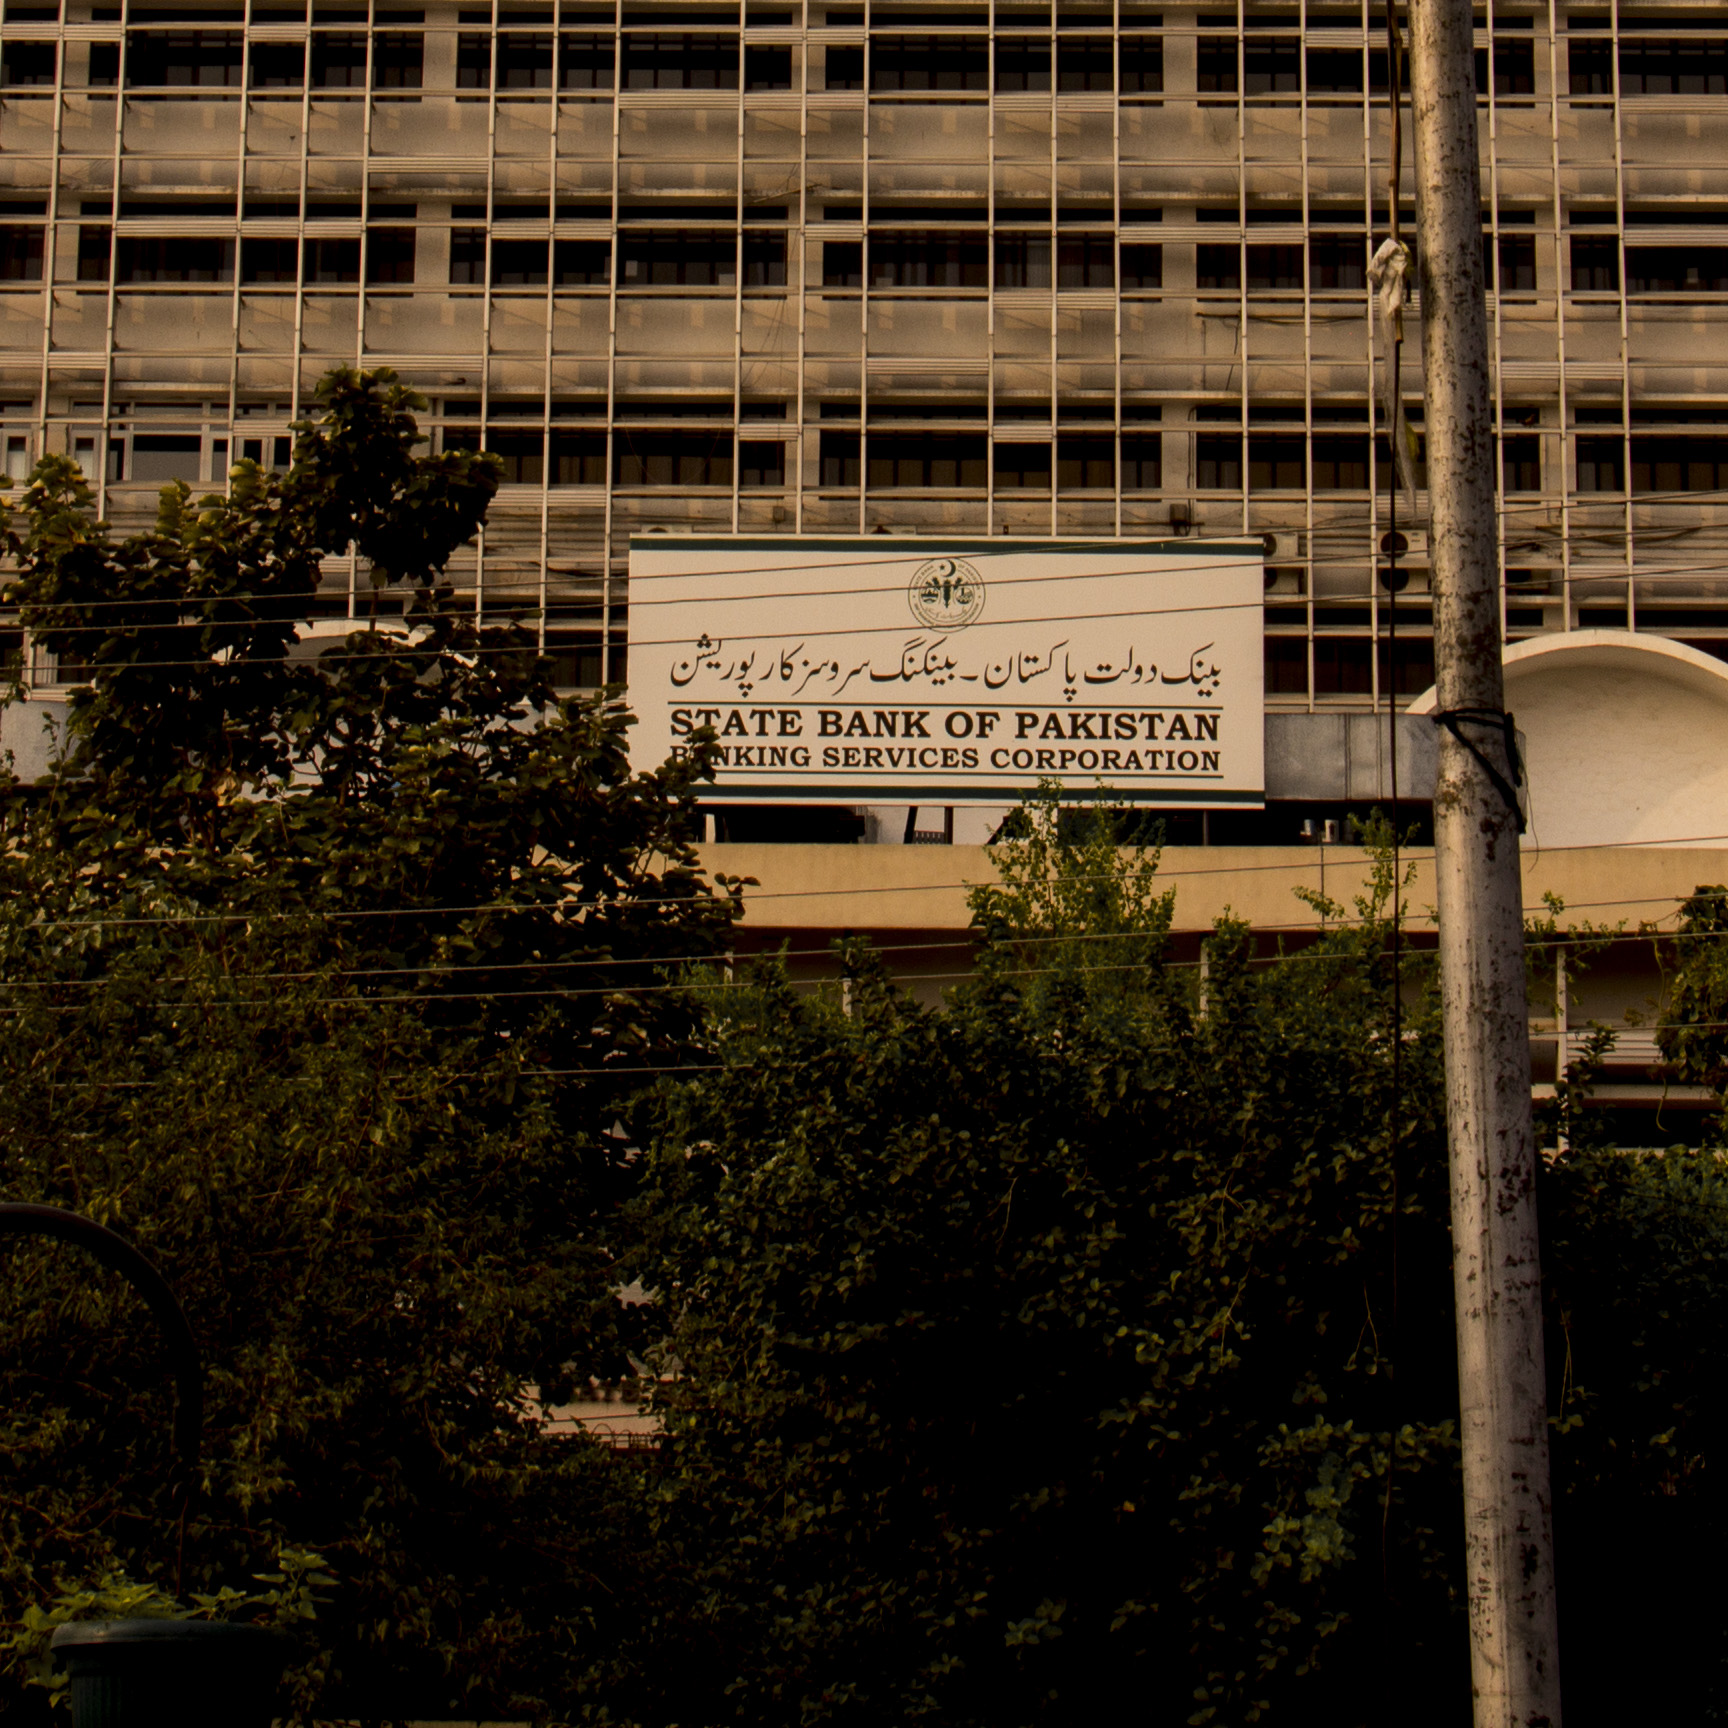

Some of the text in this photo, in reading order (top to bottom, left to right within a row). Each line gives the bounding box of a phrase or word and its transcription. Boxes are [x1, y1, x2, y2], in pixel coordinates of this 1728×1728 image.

[790, 658, 872, 697] سروسز
[868, 638, 956, 685] بینکنگ
[985, 642, 1076, 702] پاکستان
[1084, 648, 1157, 684] دولت
[1160, 642, 1222, 698] بینک
[671, 709, 1220, 740] STATE BANK OF PAKISTAN
[670, 745, 1220, 770] BNKING SERVICES CORPORATION
